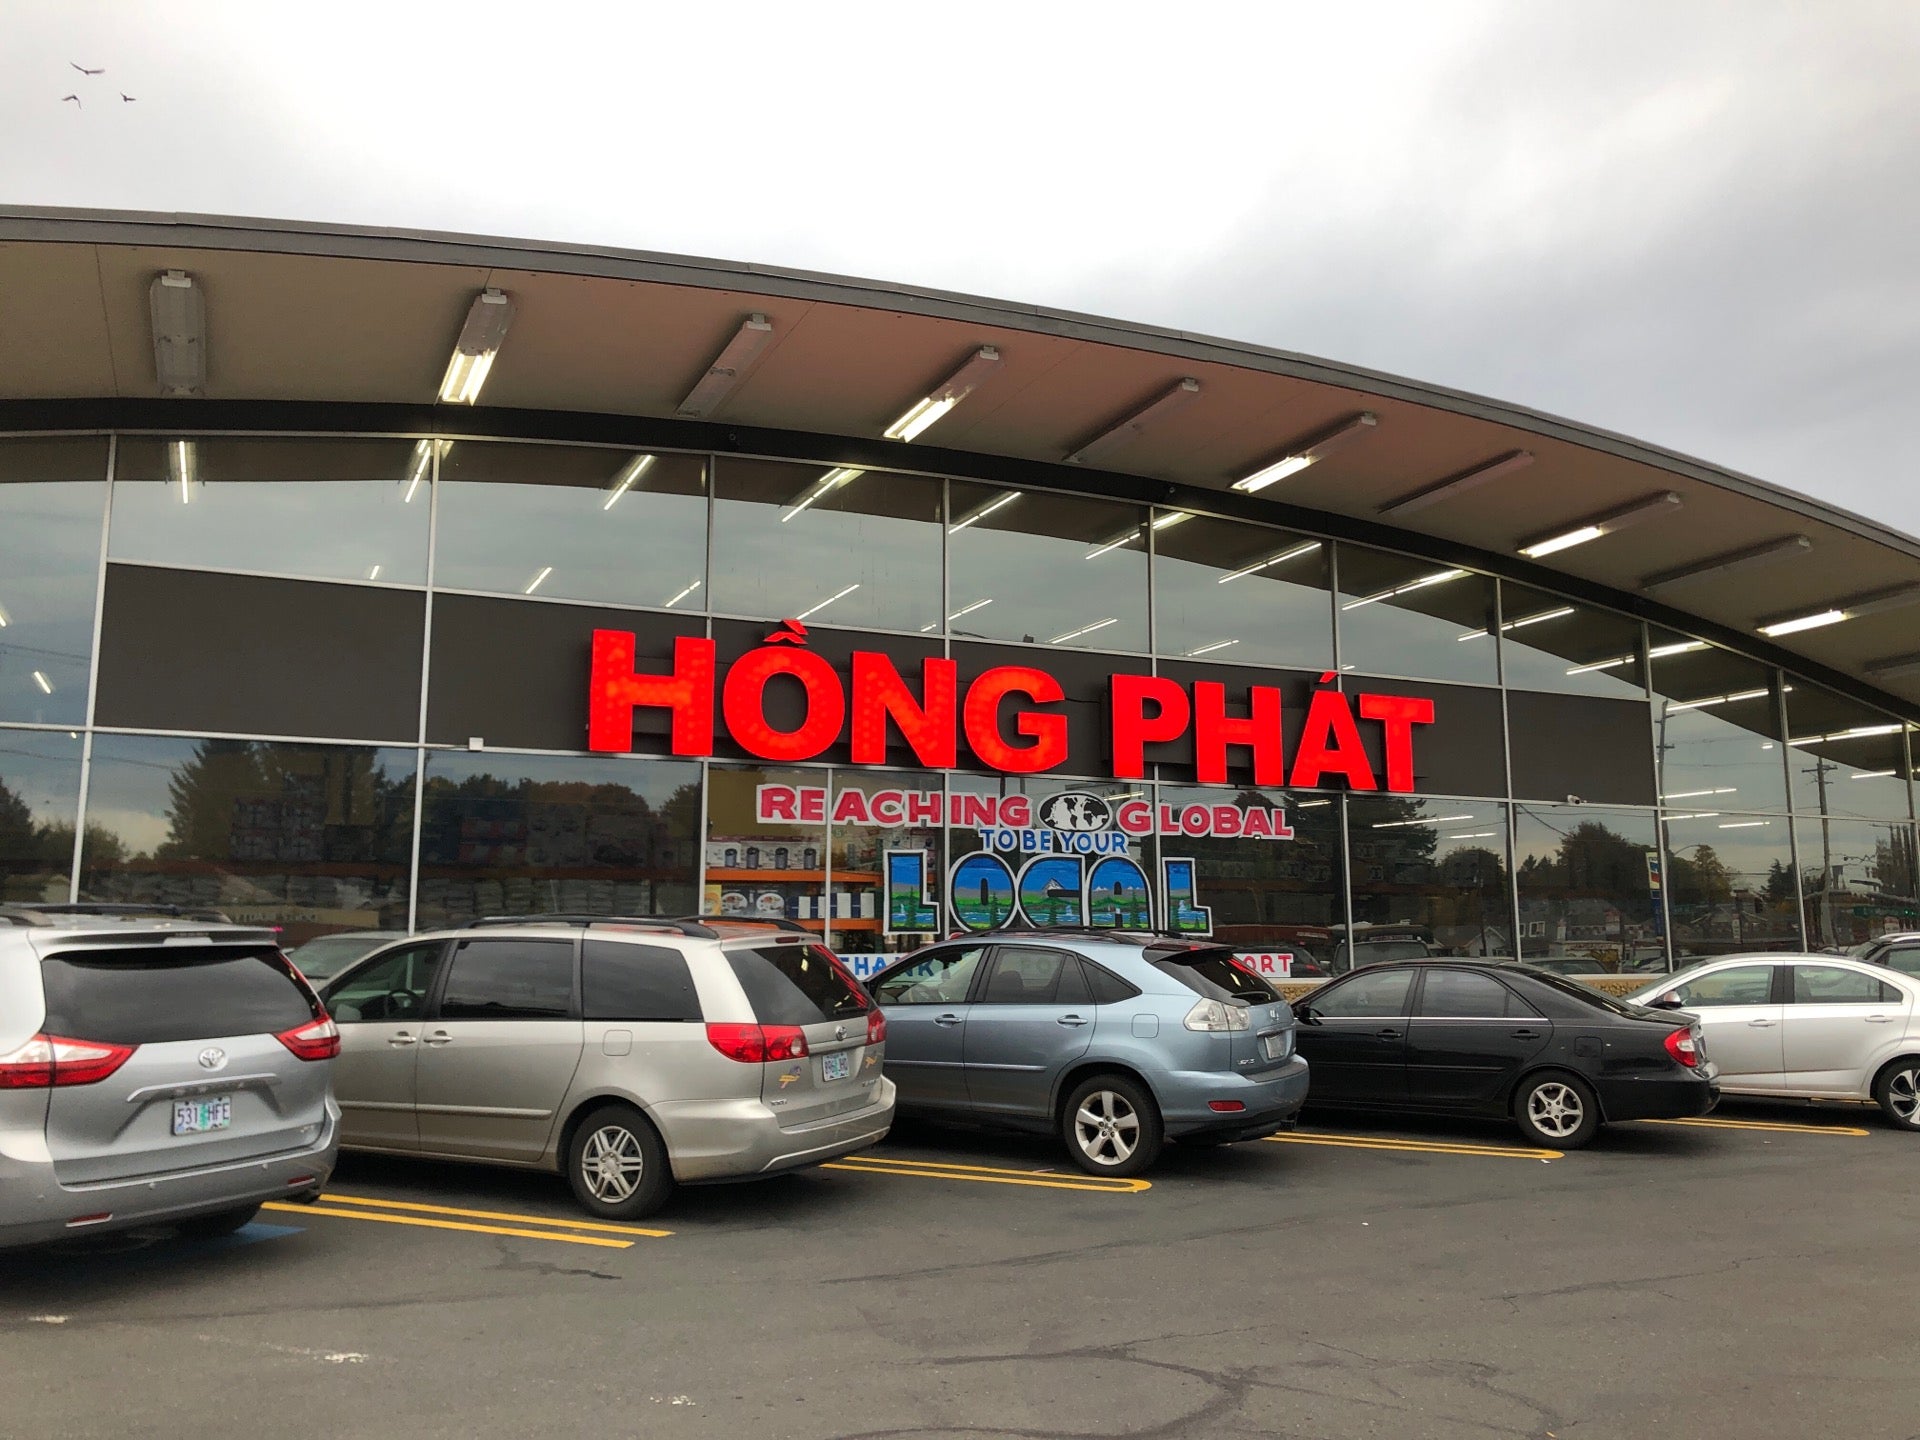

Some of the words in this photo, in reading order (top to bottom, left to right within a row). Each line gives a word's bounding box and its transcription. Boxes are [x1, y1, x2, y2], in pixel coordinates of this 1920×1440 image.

[588, 619, 1069, 774] HỒNG
[1111, 671, 1436, 794] PHÁT
[760, 786, 1030, 828] REACHING
[1118, 801, 1293, 838] GLOBAL
[979, 829, 1014, 850] TO
[1022, 830, 1053, 851] BE
[1060, 832, 1127, 854] YOUR
[886, 851, 1213, 936] LOCAL
